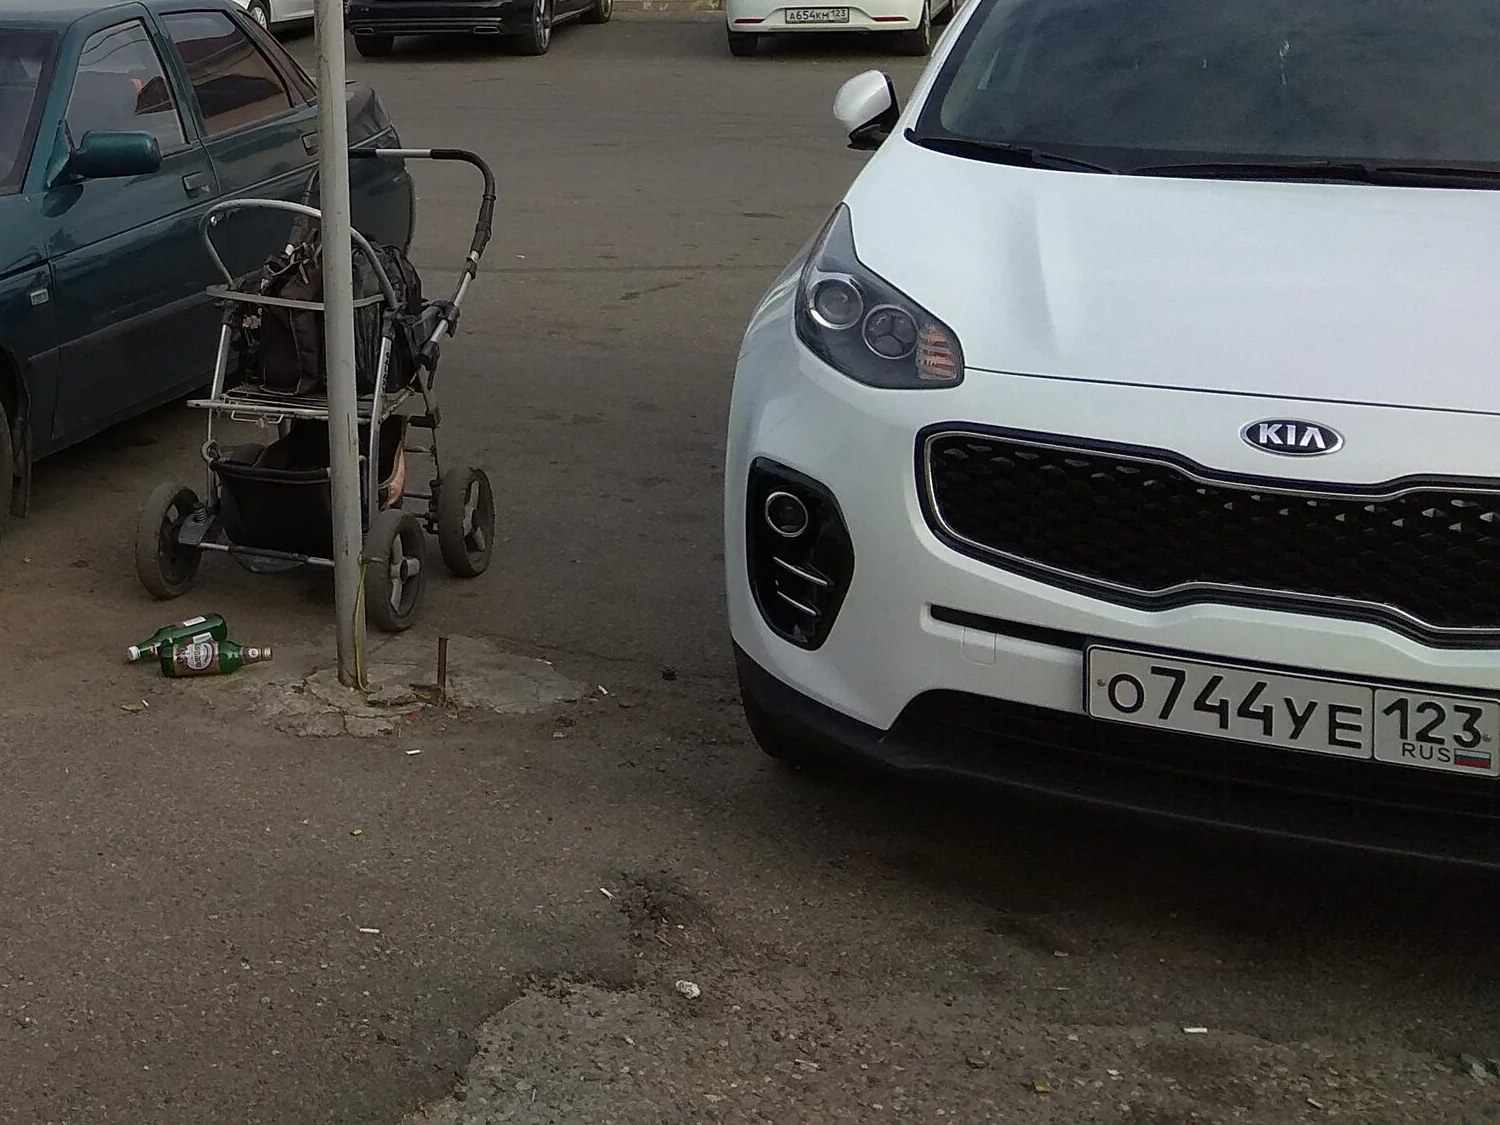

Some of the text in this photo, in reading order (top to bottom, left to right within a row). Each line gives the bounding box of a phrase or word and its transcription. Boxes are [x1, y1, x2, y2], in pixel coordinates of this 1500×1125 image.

[830, 9, 846, 17] 123
[1258, 423, 1327, 450] KIA
[1107, 665, 1484, 749] О744УЕ 123
[1401, 741, 1452, 763] RUS
